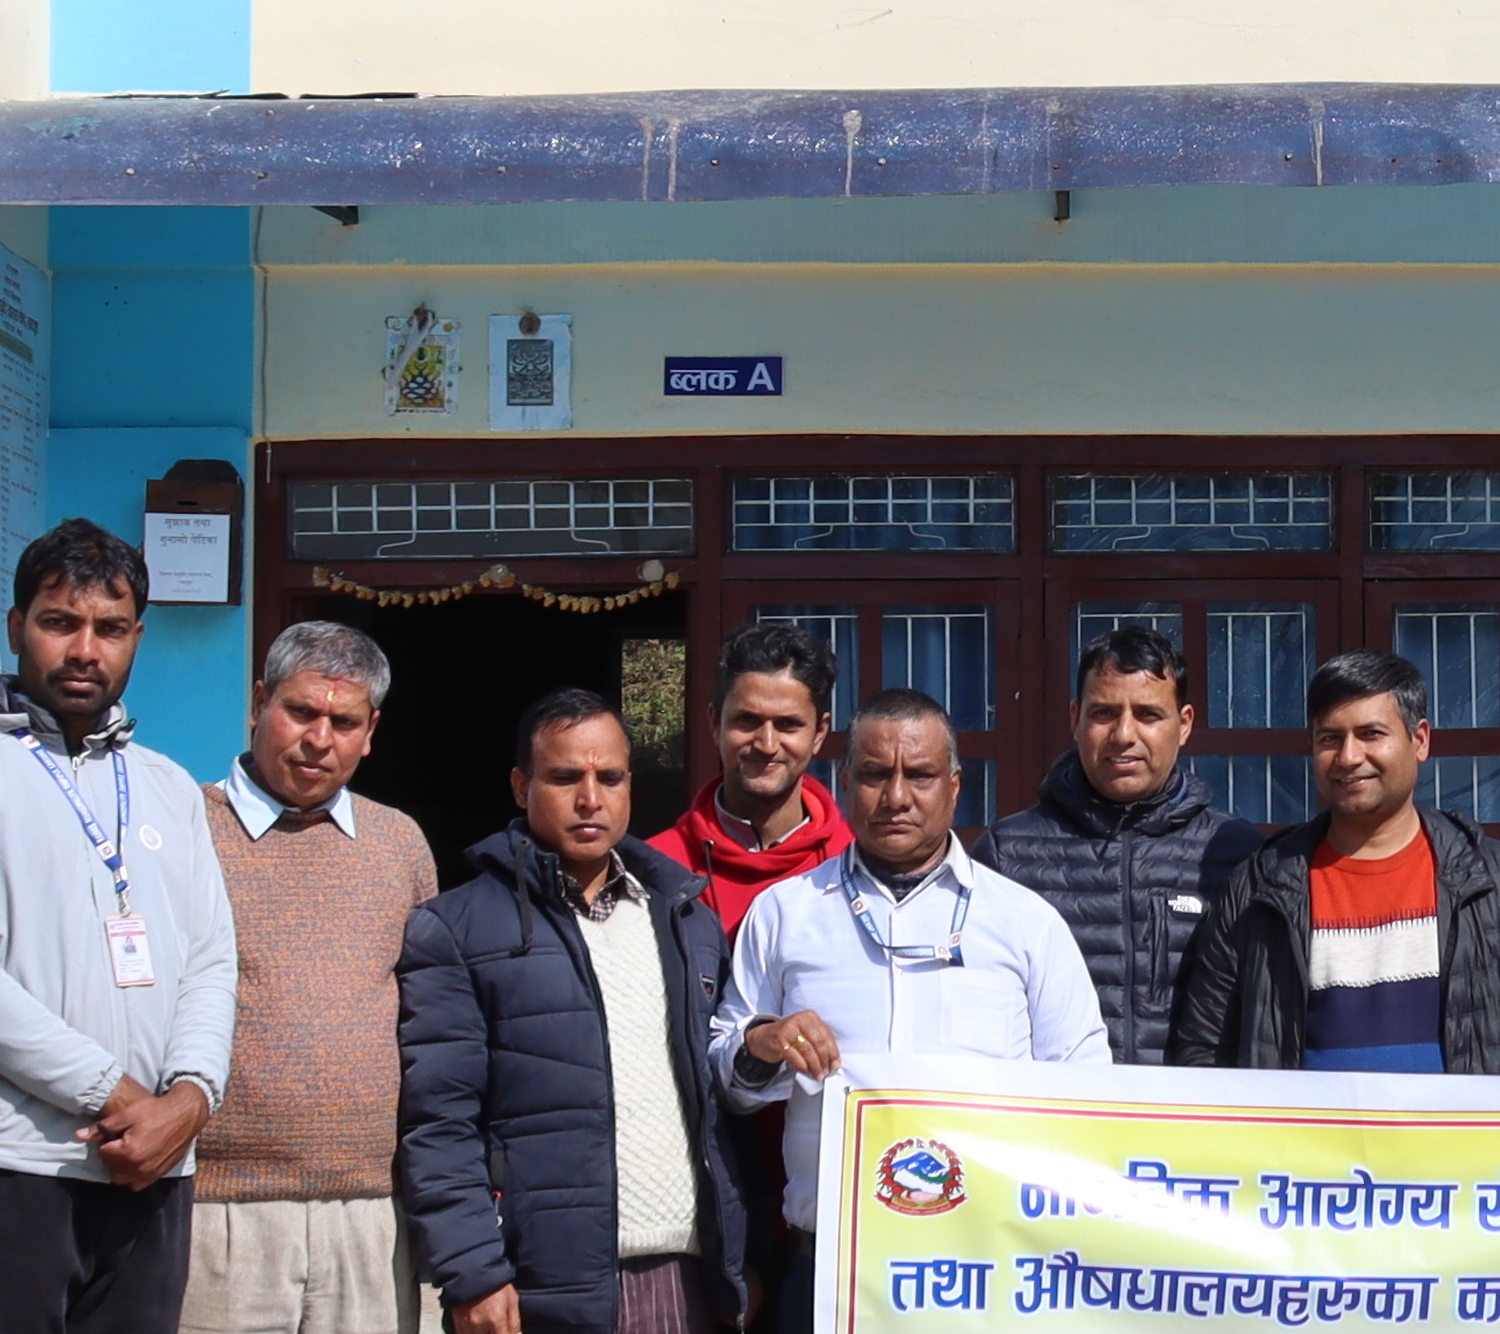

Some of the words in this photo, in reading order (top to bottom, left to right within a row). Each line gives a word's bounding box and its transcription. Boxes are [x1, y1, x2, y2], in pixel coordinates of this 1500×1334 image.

[669, 369, 738, 392] ब्लक
[746, 362, 775, 391] A
[1259, 1168, 1458, 1231] आरोग्य
[890, 1259, 995, 1313] तथा
